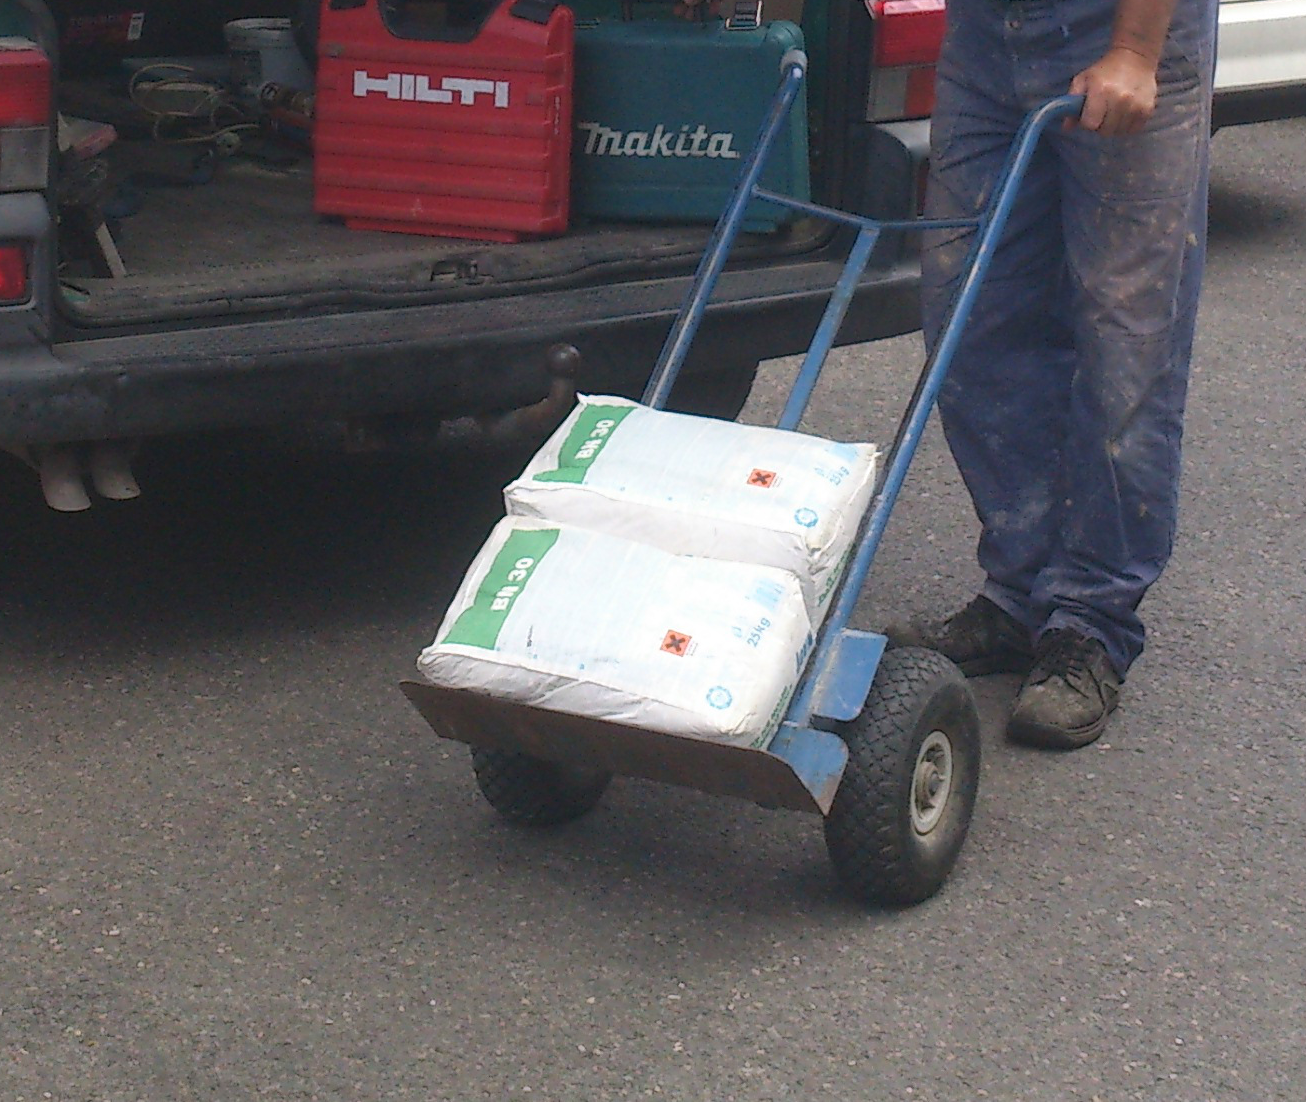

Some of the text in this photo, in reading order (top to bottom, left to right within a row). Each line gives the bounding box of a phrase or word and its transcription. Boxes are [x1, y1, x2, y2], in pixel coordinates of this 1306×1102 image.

[354, 70, 509, 108] HILTI
[590, 419, 615, 438] 30
[507, 557, 535, 582] 30
[746, 617, 771, 647] 25kg
